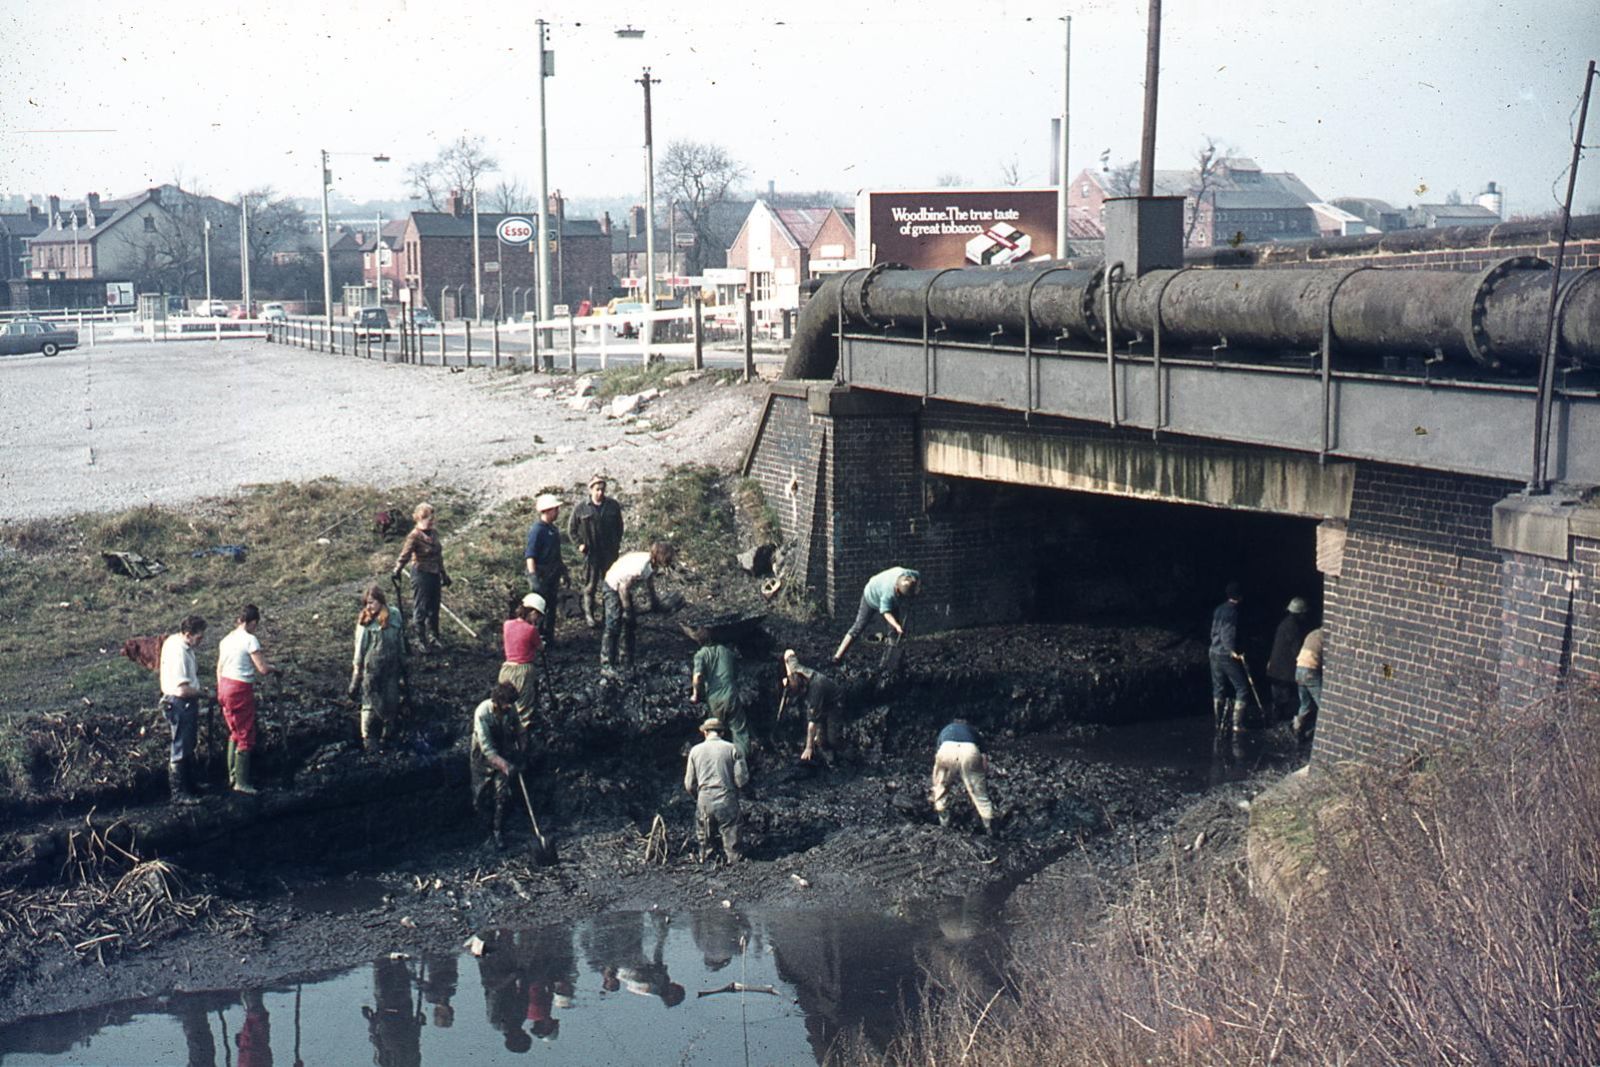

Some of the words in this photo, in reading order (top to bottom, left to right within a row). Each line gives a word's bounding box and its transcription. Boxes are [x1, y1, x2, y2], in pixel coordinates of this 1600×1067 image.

[970, 208, 993, 220] true
[994, 208, 1020, 220] taste
[505, 225, 530, 236] Esso
[900, 221, 912, 235] of
[912, 223, 940, 238] great
[941, 220, 985, 235] tobacco.
